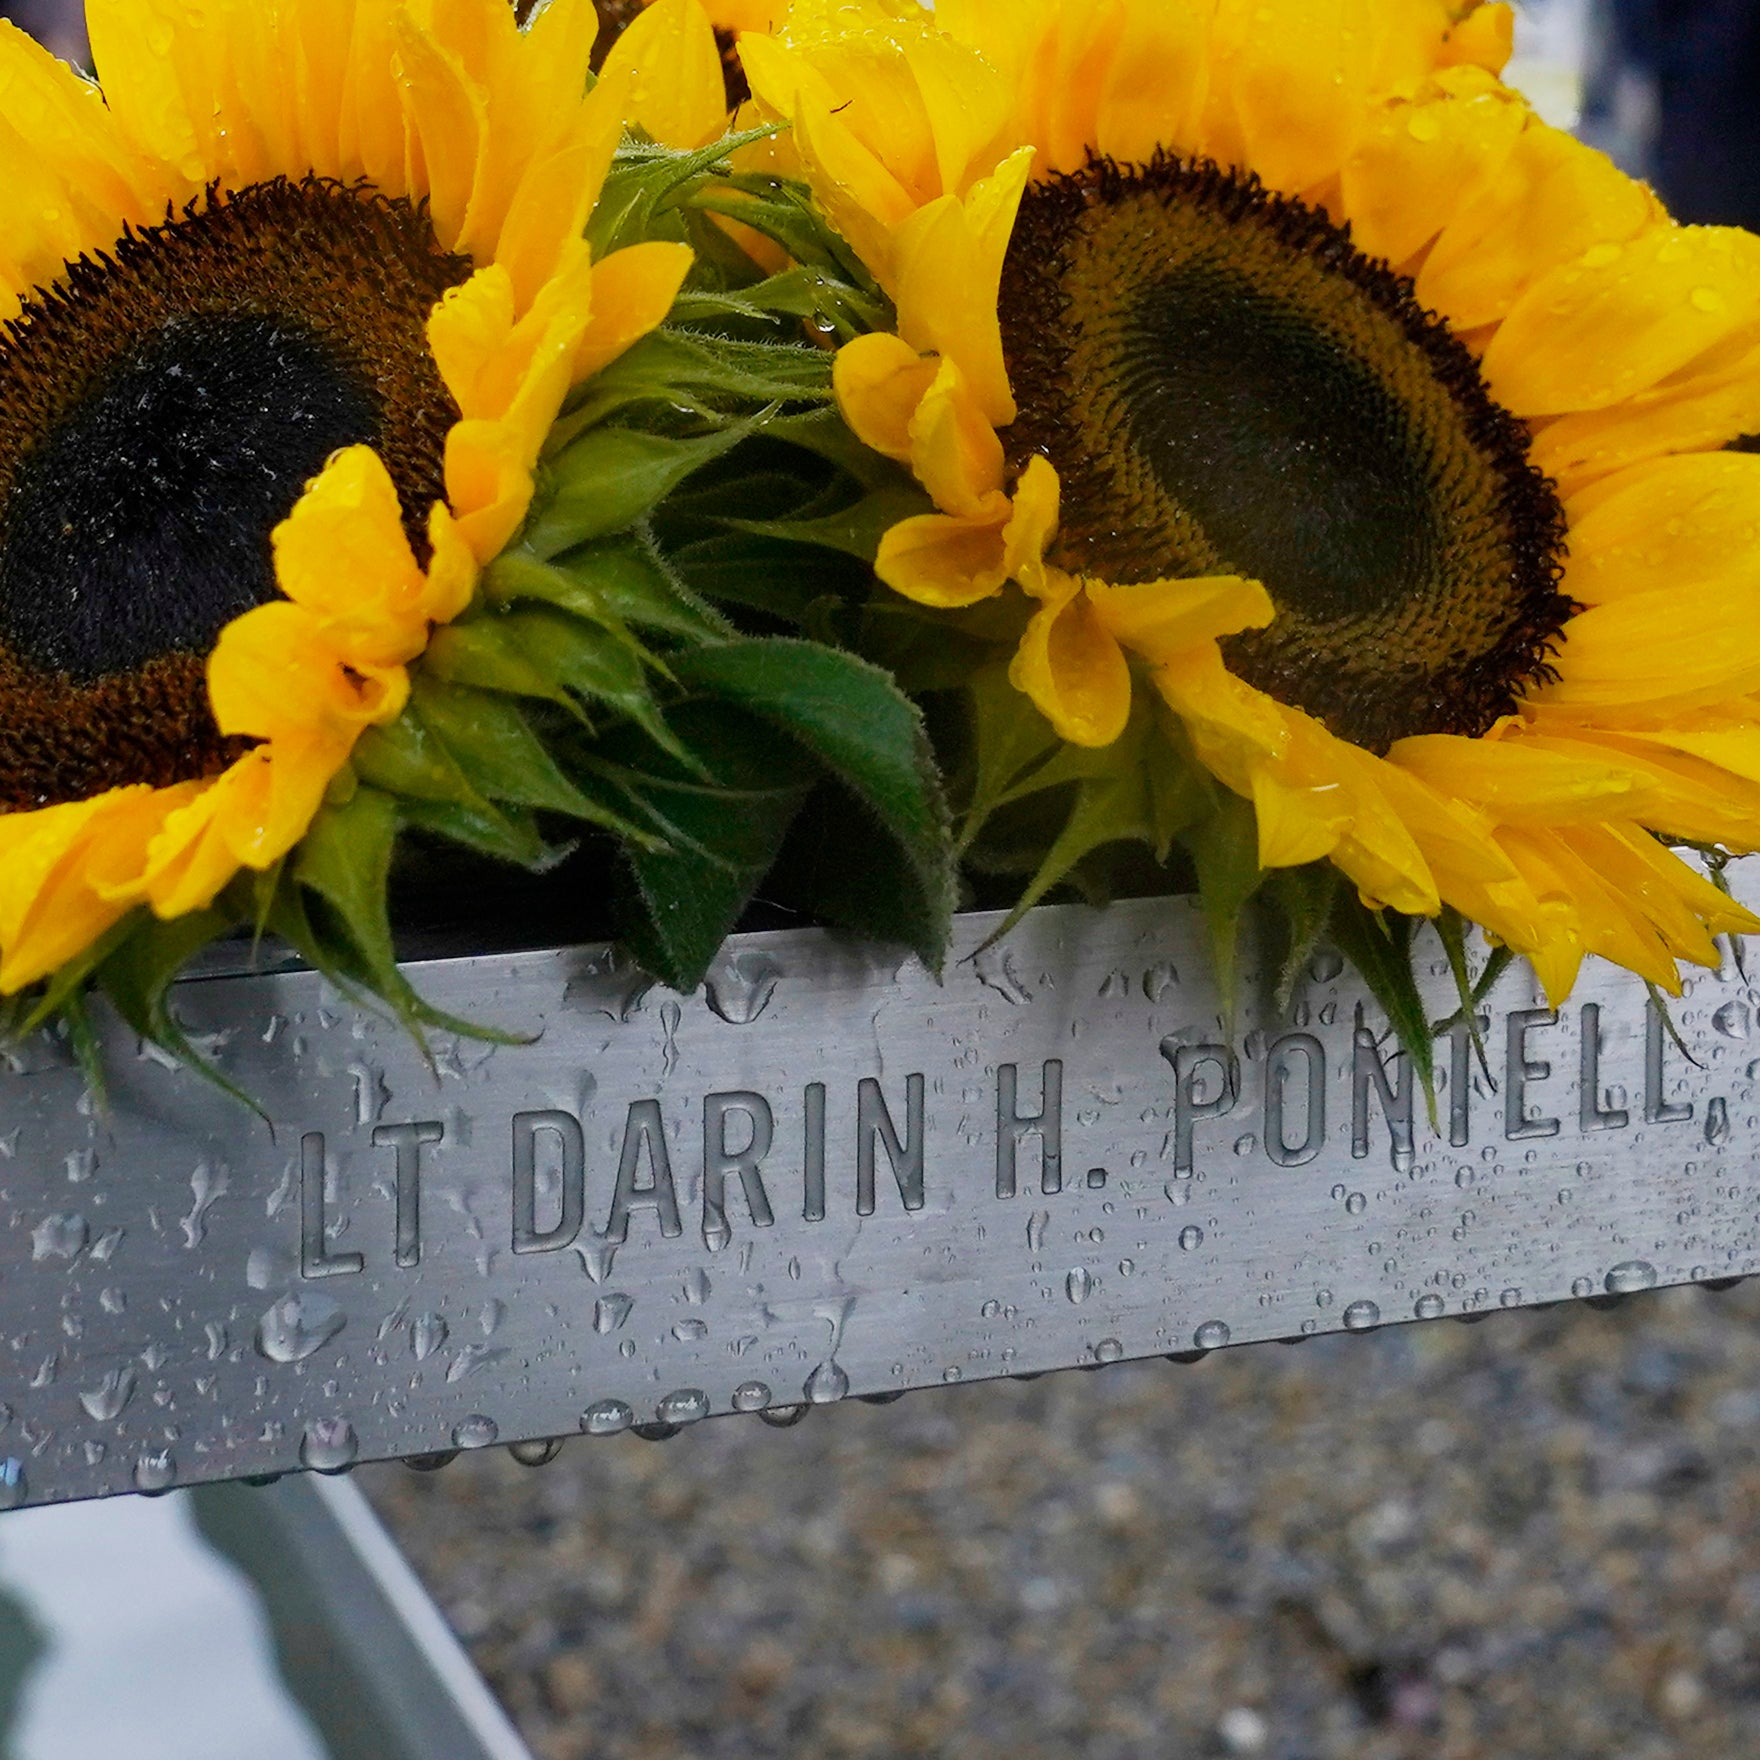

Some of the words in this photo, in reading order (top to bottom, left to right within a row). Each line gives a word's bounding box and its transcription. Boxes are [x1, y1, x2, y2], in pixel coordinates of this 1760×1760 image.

[300, 1121, 443, 1279] LT
[511, 1072, 926, 1255] DARIN
[996, 1059, 1108, 1200] H.
